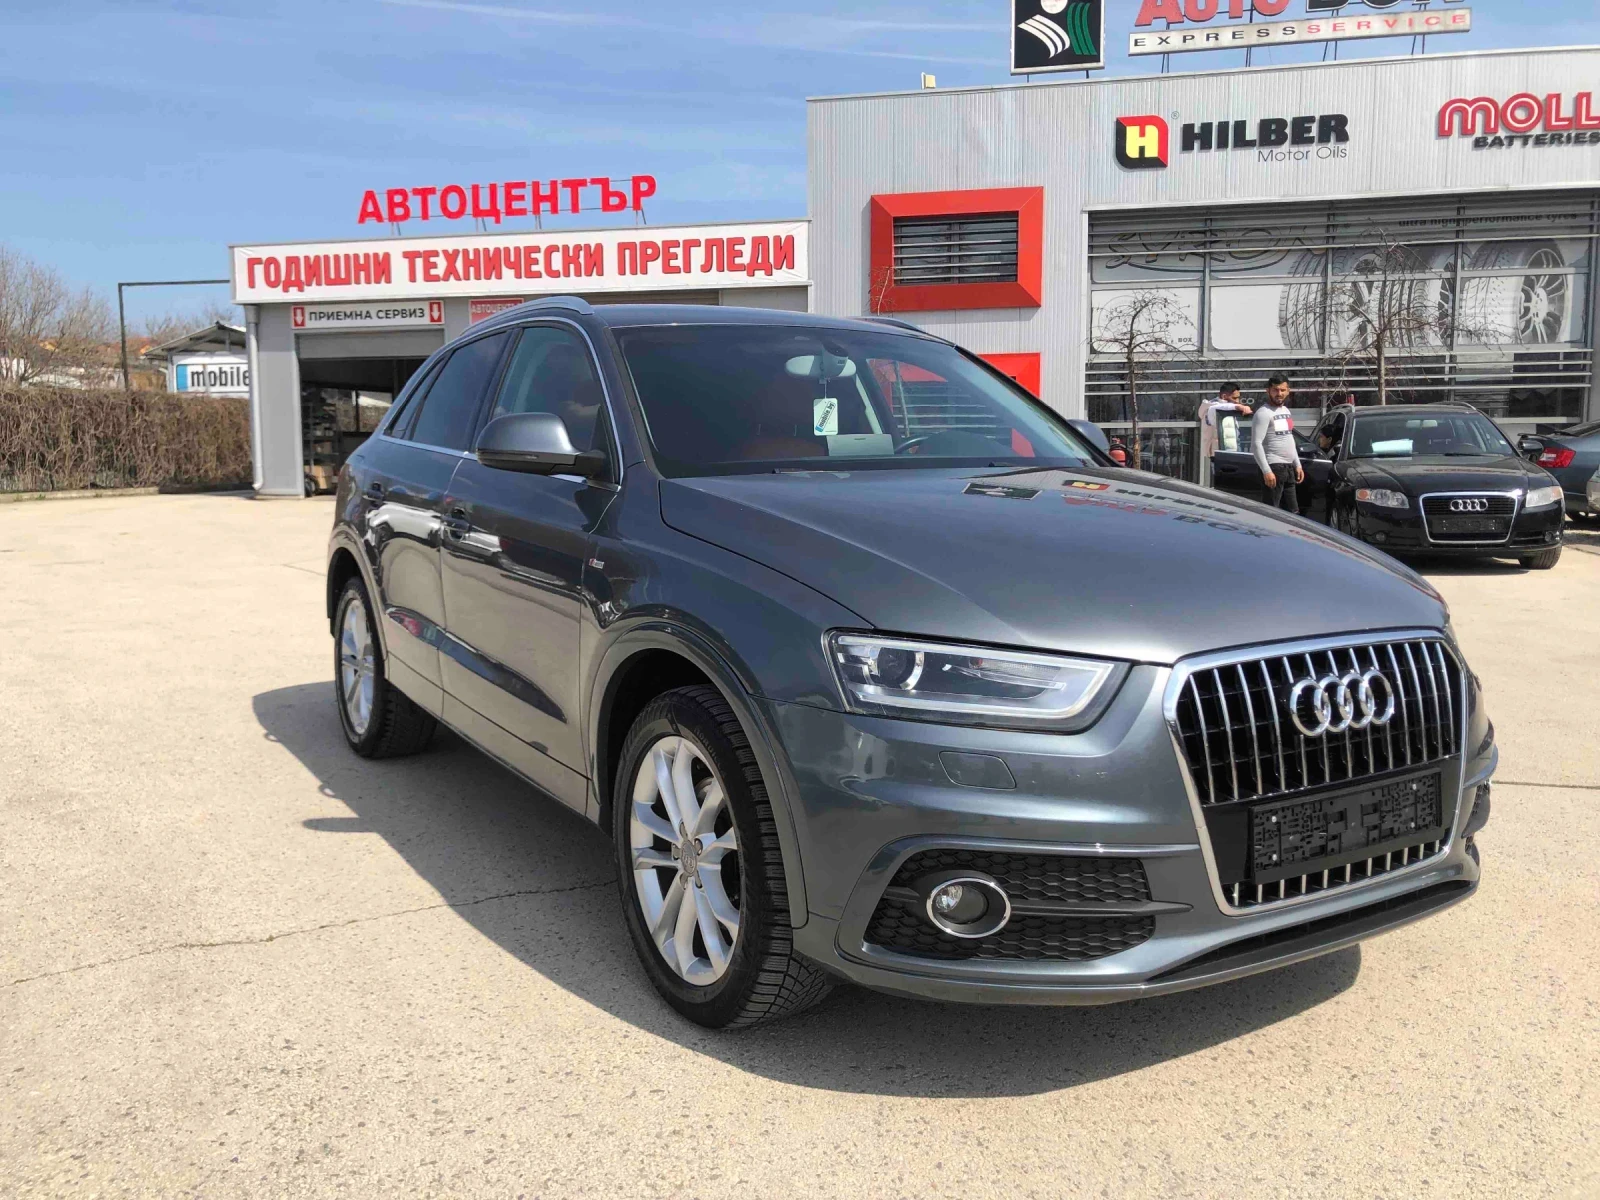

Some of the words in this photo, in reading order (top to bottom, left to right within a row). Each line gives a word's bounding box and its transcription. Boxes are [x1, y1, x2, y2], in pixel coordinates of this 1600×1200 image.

[1182, 113, 1349, 151] HILBER
[1474, 132, 1600, 148] BATTERIES
[1258, 149, 1310, 163] Motor
[1316, 146, 1347, 160] Oils
[357, 174, 657, 224] АВТОЦЕНТЪР
[247, 252, 392, 293] ГОДИШНИ
[403, 242, 604, 283] ТЕХНИЧЕСКИ
[618, 234, 795, 277] ПРЕГЛЕДИ
[309, 310, 373, 321] ПРИЕМНА
[376, 308, 425, 319] СЕРВИЗ
[191, 366, 249, 388] mobile
